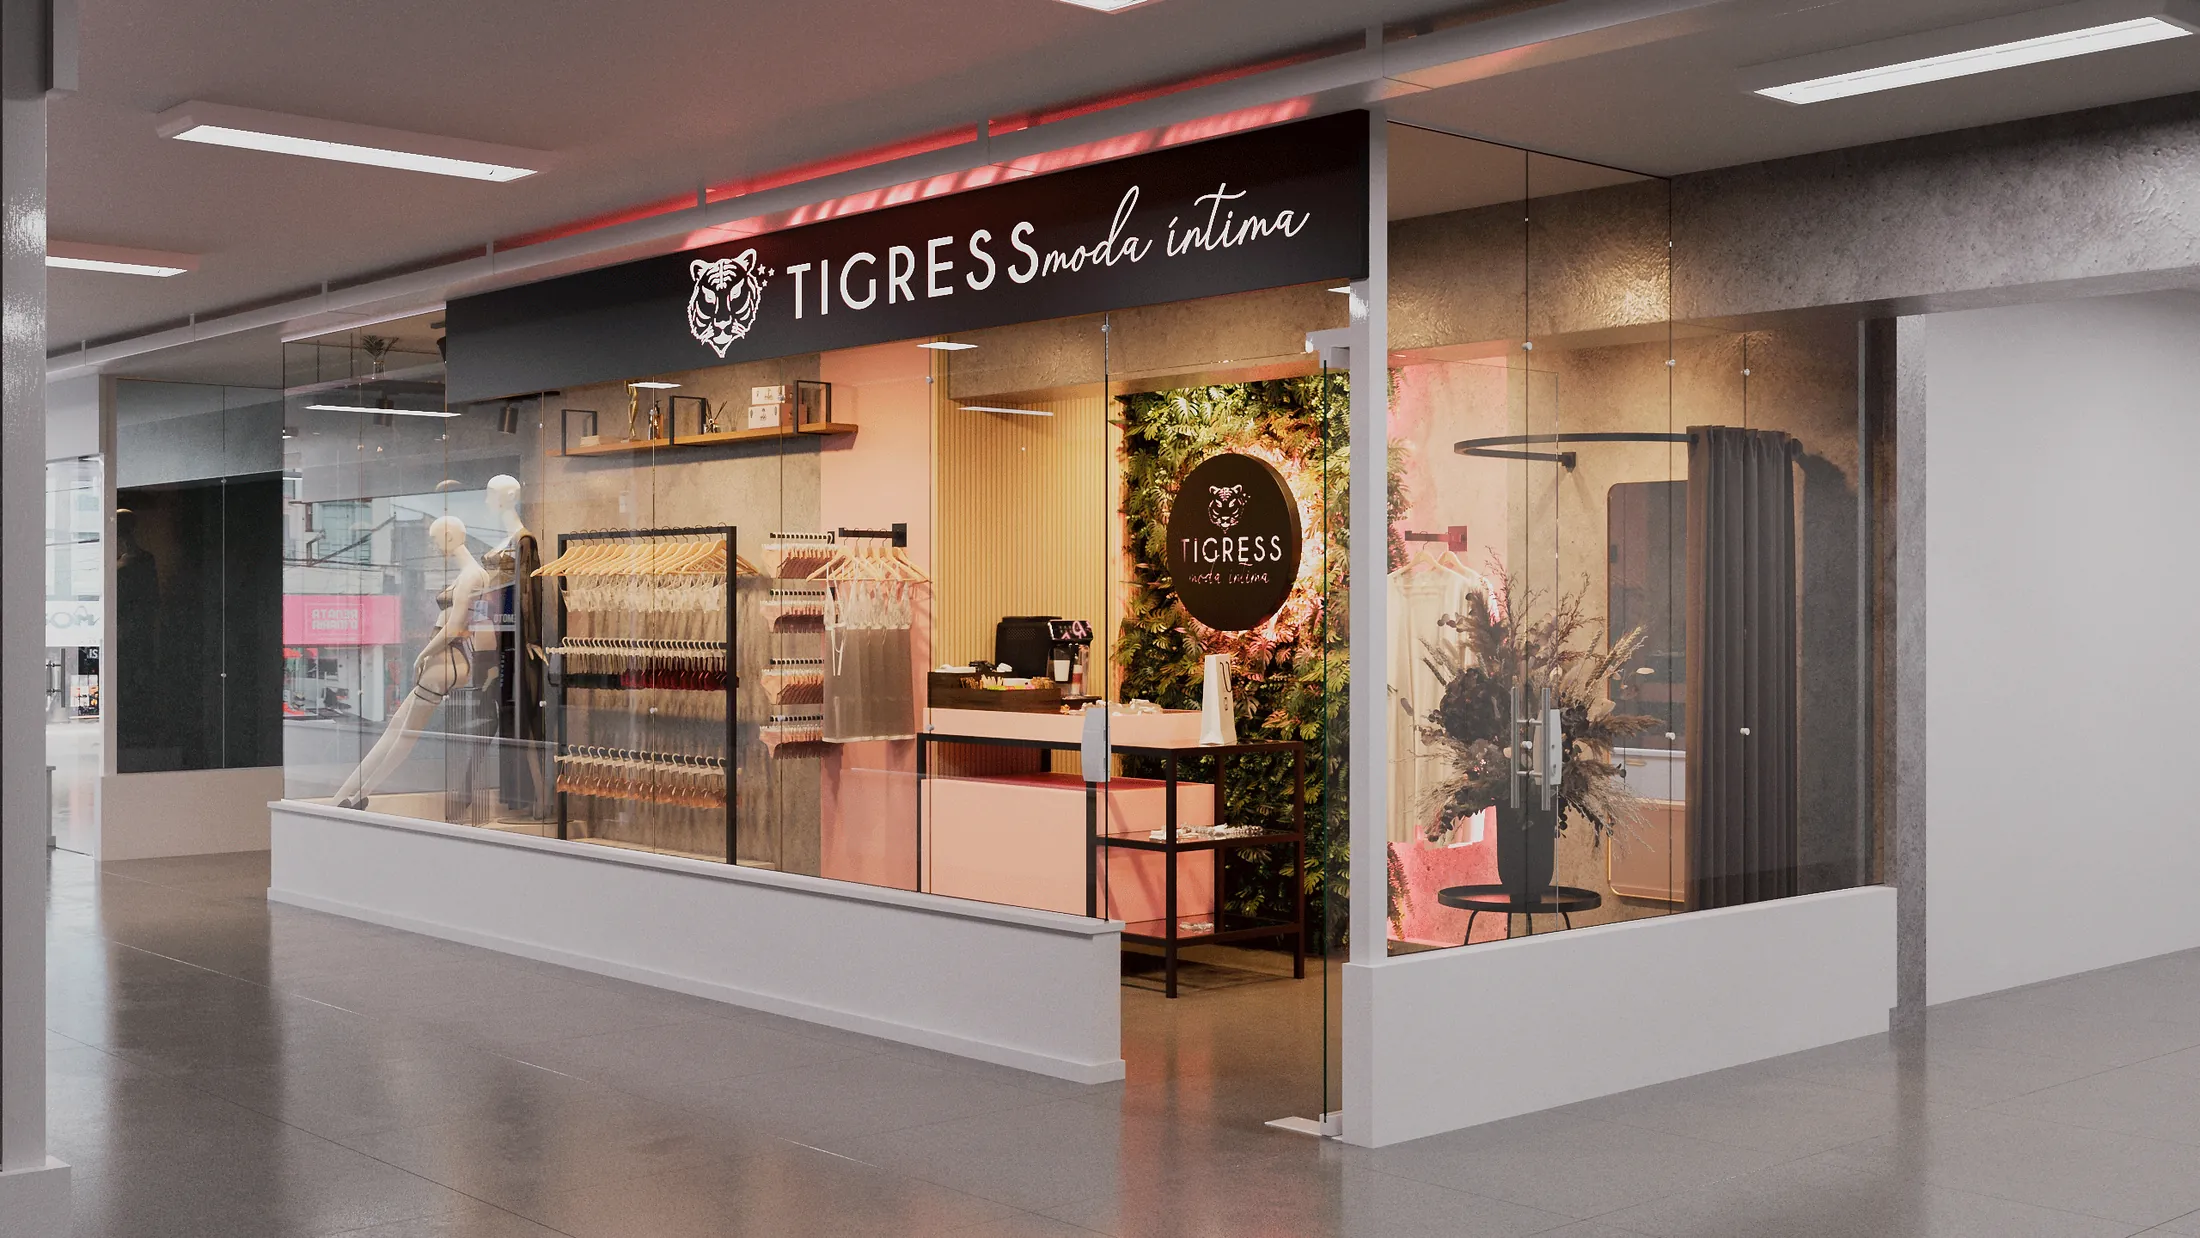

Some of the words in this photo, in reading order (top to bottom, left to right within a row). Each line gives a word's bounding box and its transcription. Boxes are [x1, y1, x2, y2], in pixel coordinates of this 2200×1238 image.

[787, 221, 1039, 319] TIGRESS
[1041, 185, 1153, 277] moda
[1166, 182, 1311, 257] íntima
[1180, 534, 1282, 563] TIGRESS
[1188, 560, 1221, 585] moda
